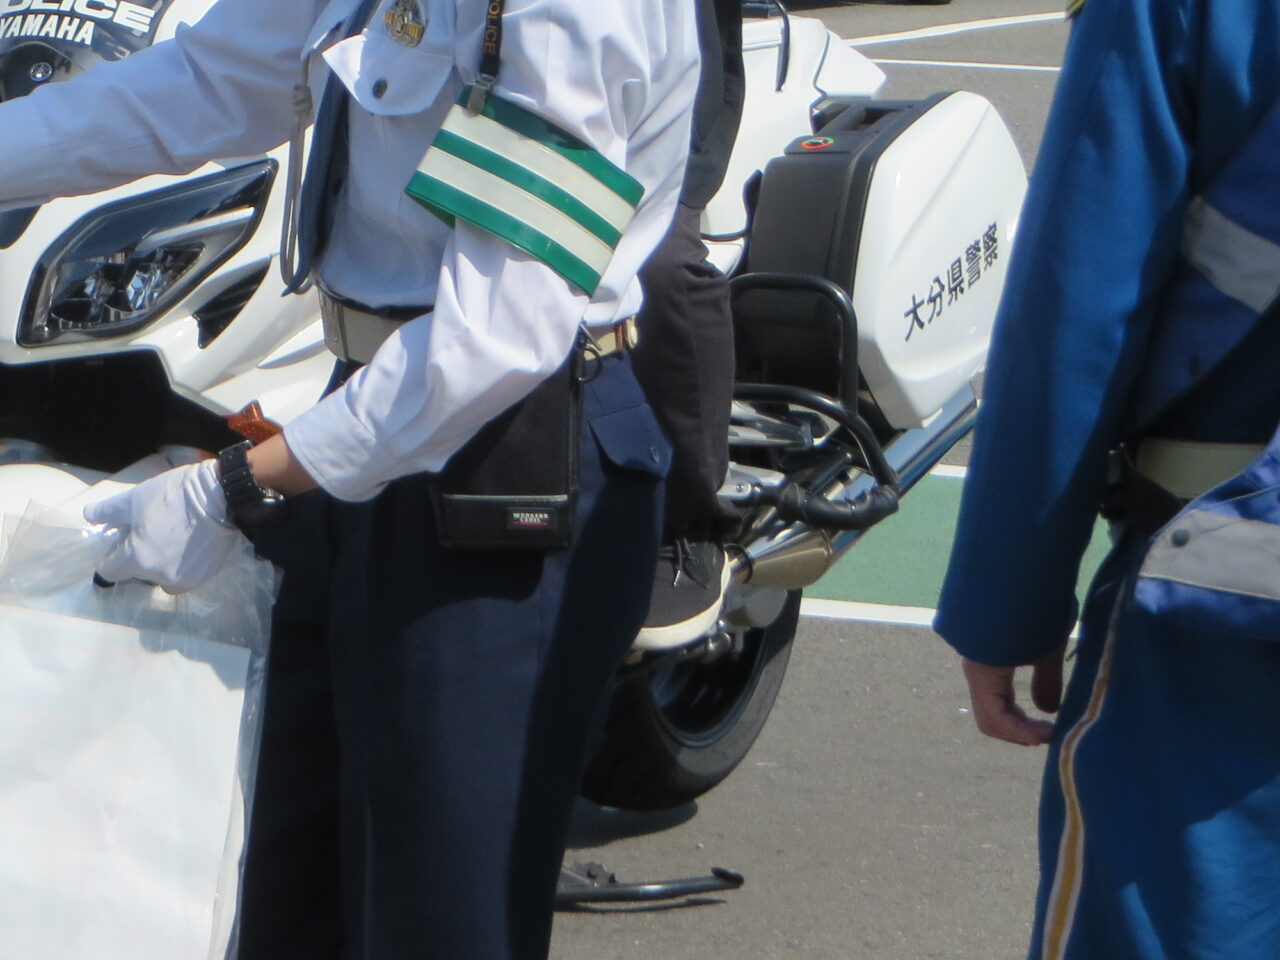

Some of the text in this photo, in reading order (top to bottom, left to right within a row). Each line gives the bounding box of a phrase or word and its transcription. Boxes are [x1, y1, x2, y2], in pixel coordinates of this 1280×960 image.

[903, 221, 999, 342] 大分県警察
